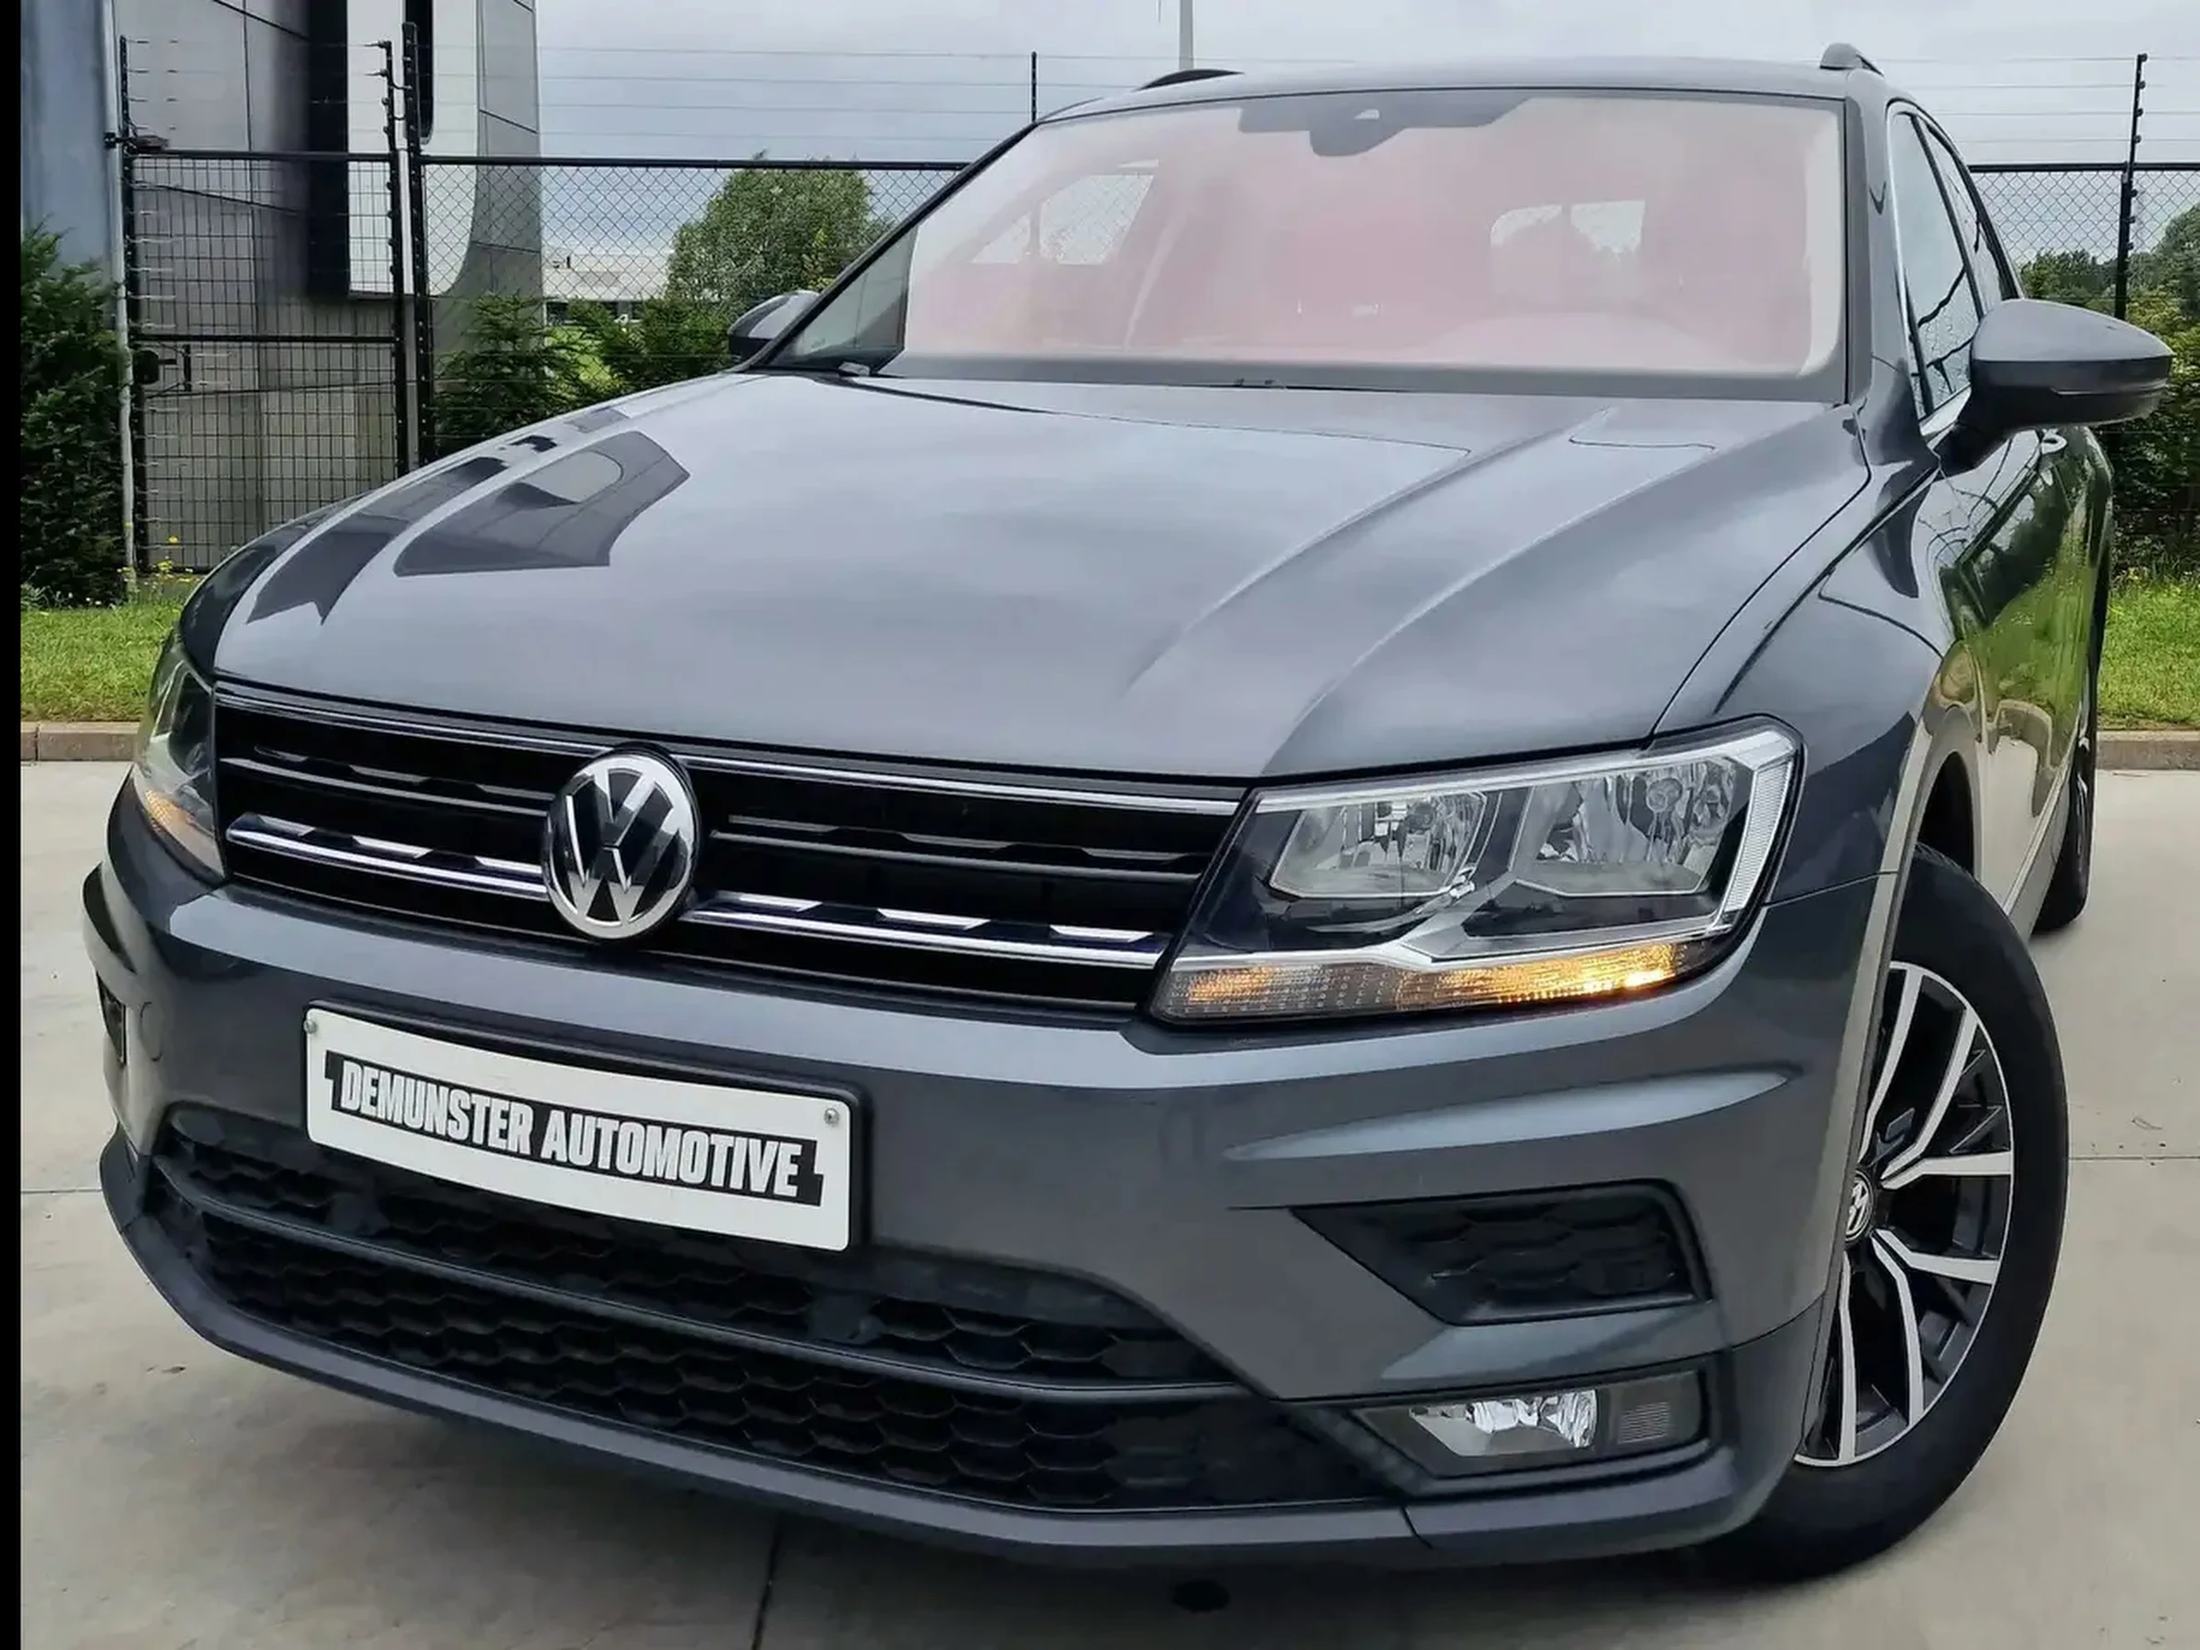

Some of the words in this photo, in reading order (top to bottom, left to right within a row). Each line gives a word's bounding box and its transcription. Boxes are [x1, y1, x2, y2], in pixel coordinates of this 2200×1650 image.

[551, 758, 691, 933] VW
[340, 1060, 535, 1155] DEMUNSTER
[540, 1109, 803, 1198] AUTOMOTIVE
